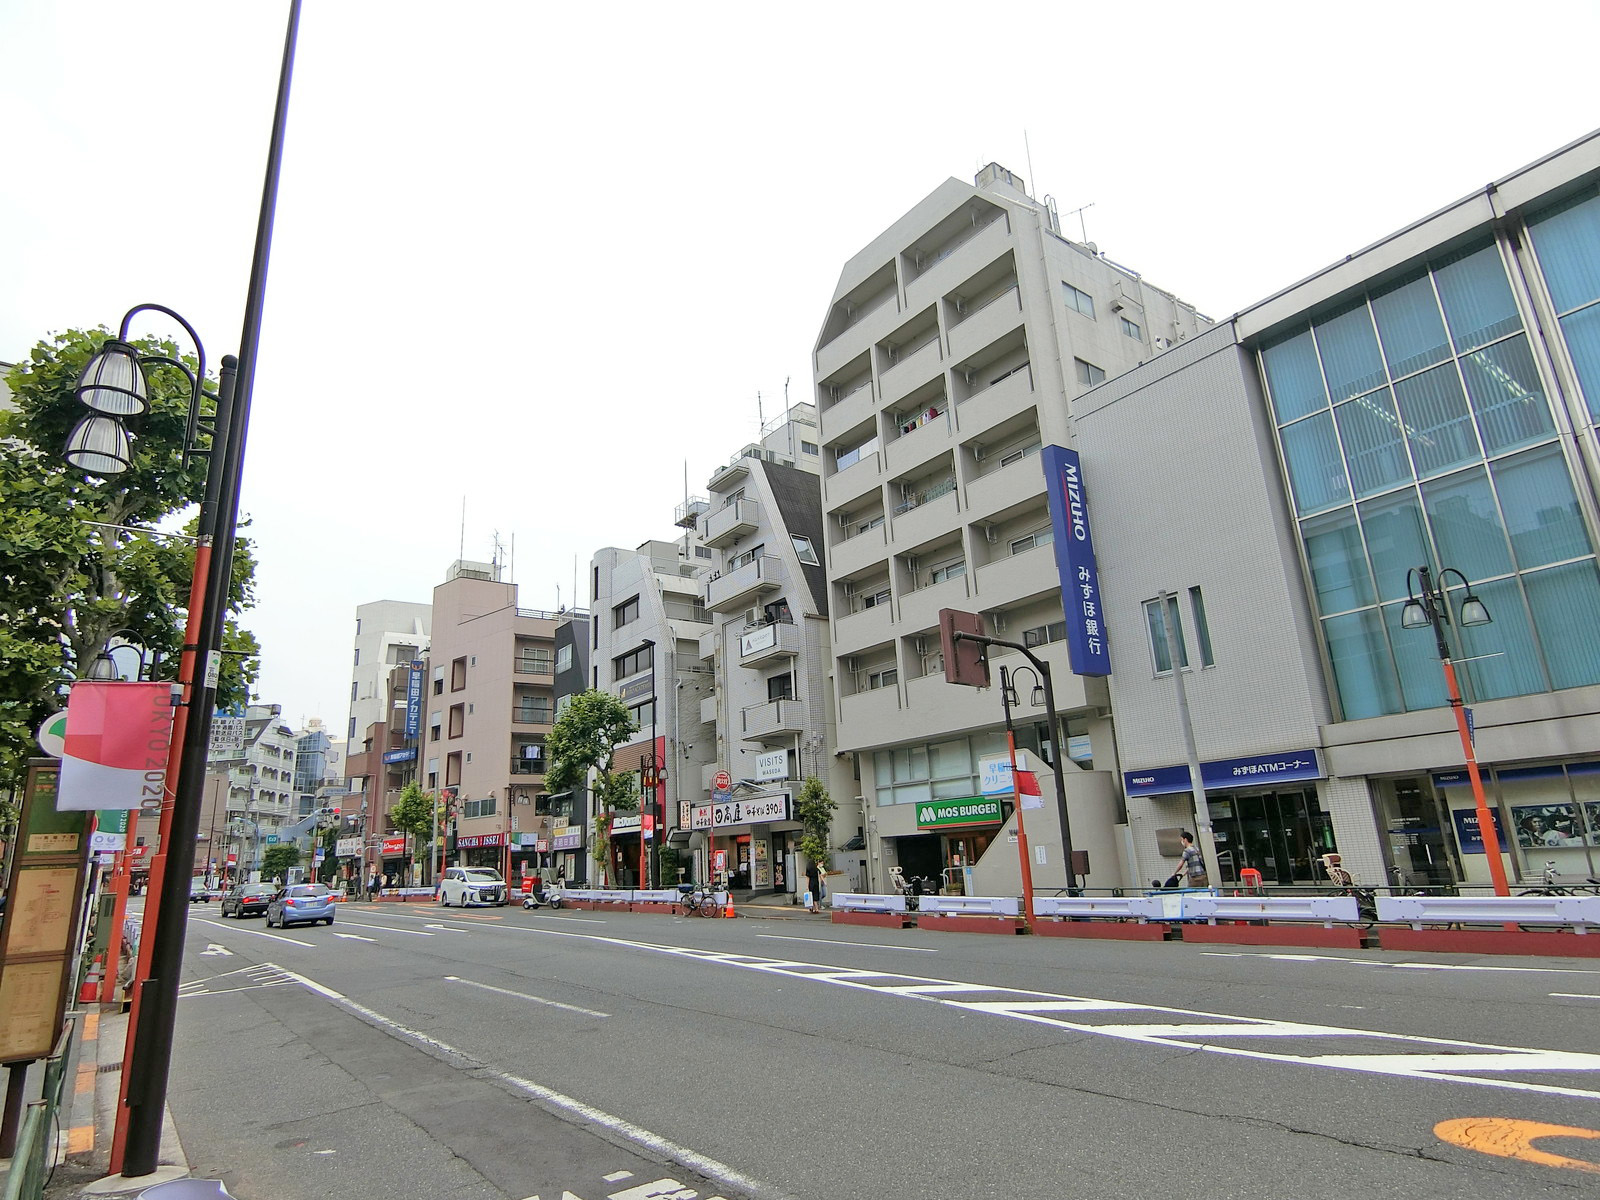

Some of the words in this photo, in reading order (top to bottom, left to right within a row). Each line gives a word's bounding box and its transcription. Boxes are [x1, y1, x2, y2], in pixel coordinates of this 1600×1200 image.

[1064, 462, 1086, 542] MIZUHO
[1078, 566, 1101, 655] みずほ銀行
[759, 755, 783, 768] VISITS
[1232, 759, 1310, 776] みずほATMコーナー
[1132, 776, 1155, 784] MIZUHO
[938, 806, 959, 819] MOS
[960, 803, 998, 816] BURGER
